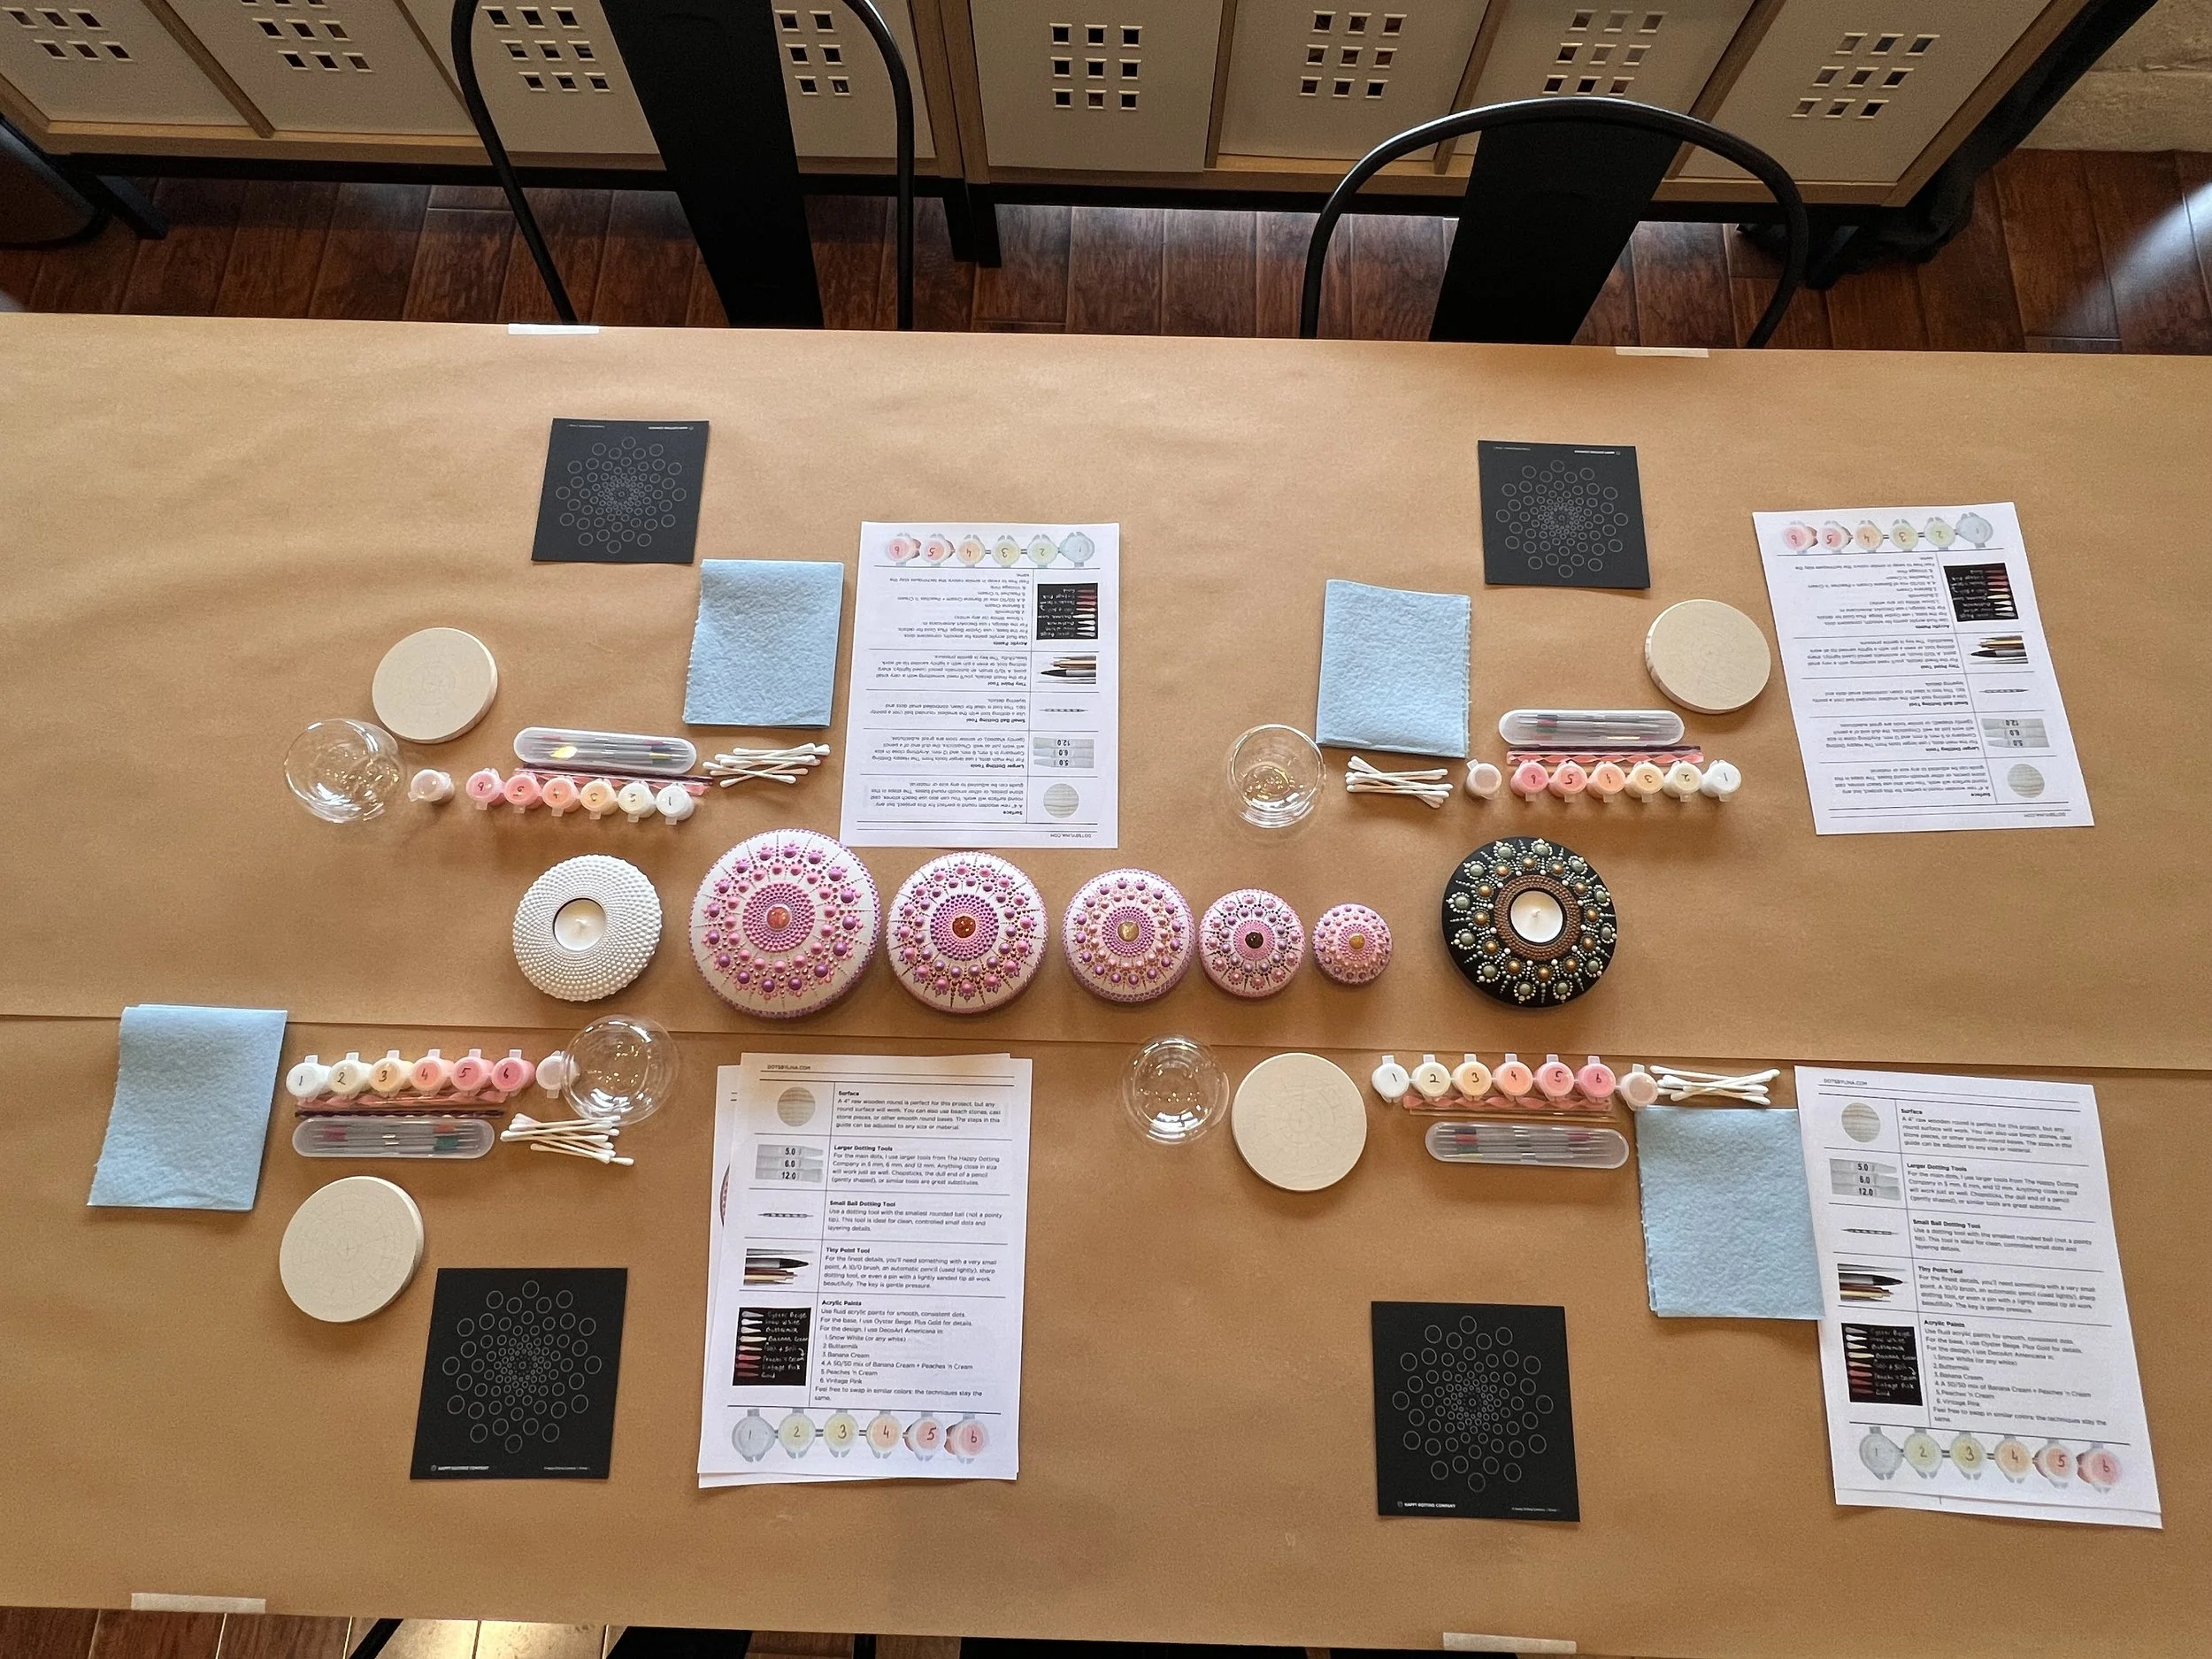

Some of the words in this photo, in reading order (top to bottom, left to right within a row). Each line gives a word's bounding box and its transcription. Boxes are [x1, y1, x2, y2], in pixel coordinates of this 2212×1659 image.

[1791, 534, 1799, 544] 6
[1825, 534, 1835, 544] 5
[1863, 533, 1871, 543] 4
[1898, 531, 1909, 542] 3
[1936, 530, 1945, 539] 2
[894, 546, 900, 556] 6
[928, 547, 936, 557] 5
[965, 548, 972, 557] 4
[1001, 548, 1009, 558] 3
[1038, 548, 1045, 557] 2
[1564, 774, 1574, 784] 5
[1644, 774, 1652, 783] 3
[379, 1070, 388, 1082] 3
[420, 1068, 428, 1080] 4
[458, 1067, 471, 1078] 5
[503, 1067, 510, 1079] 6
[1471, 1072, 1479, 1082] 3
[1510, 1071, 1517, 1080] 4
[1555, 1071, 1563, 1082] 5
[336, 1072, 347, 1086] 2
[1429, 1073, 1440, 1083] 2
[1596, 1073, 1601, 1083] 6
[784, 1147, 796, 1156] 5.0
[783, 1159, 795, 1168] 6.0
[1856, 1163, 1869, 1171] 5.0
[780, 1171, 796, 1180] 12.0
[1858, 1175, 1870, 1185] 6.0
[1857, 1187, 1874, 1196] 12.0
[793, 1425, 802, 1438] 2
[837, 1424, 847, 1439] 3
[881, 1425, 890, 1440] 4
[926, 1426, 936, 1440] 5
[970, 1429, 978, 1443] 6
[1918, 1446, 1928, 1458] 2
[1963, 1446, 1975, 1462] 3
[2010, 1449, 2019, 1464] 4
[2055, 1453, 2067, 1468] 5
[2101, 1458, 2111, 1473] 6
